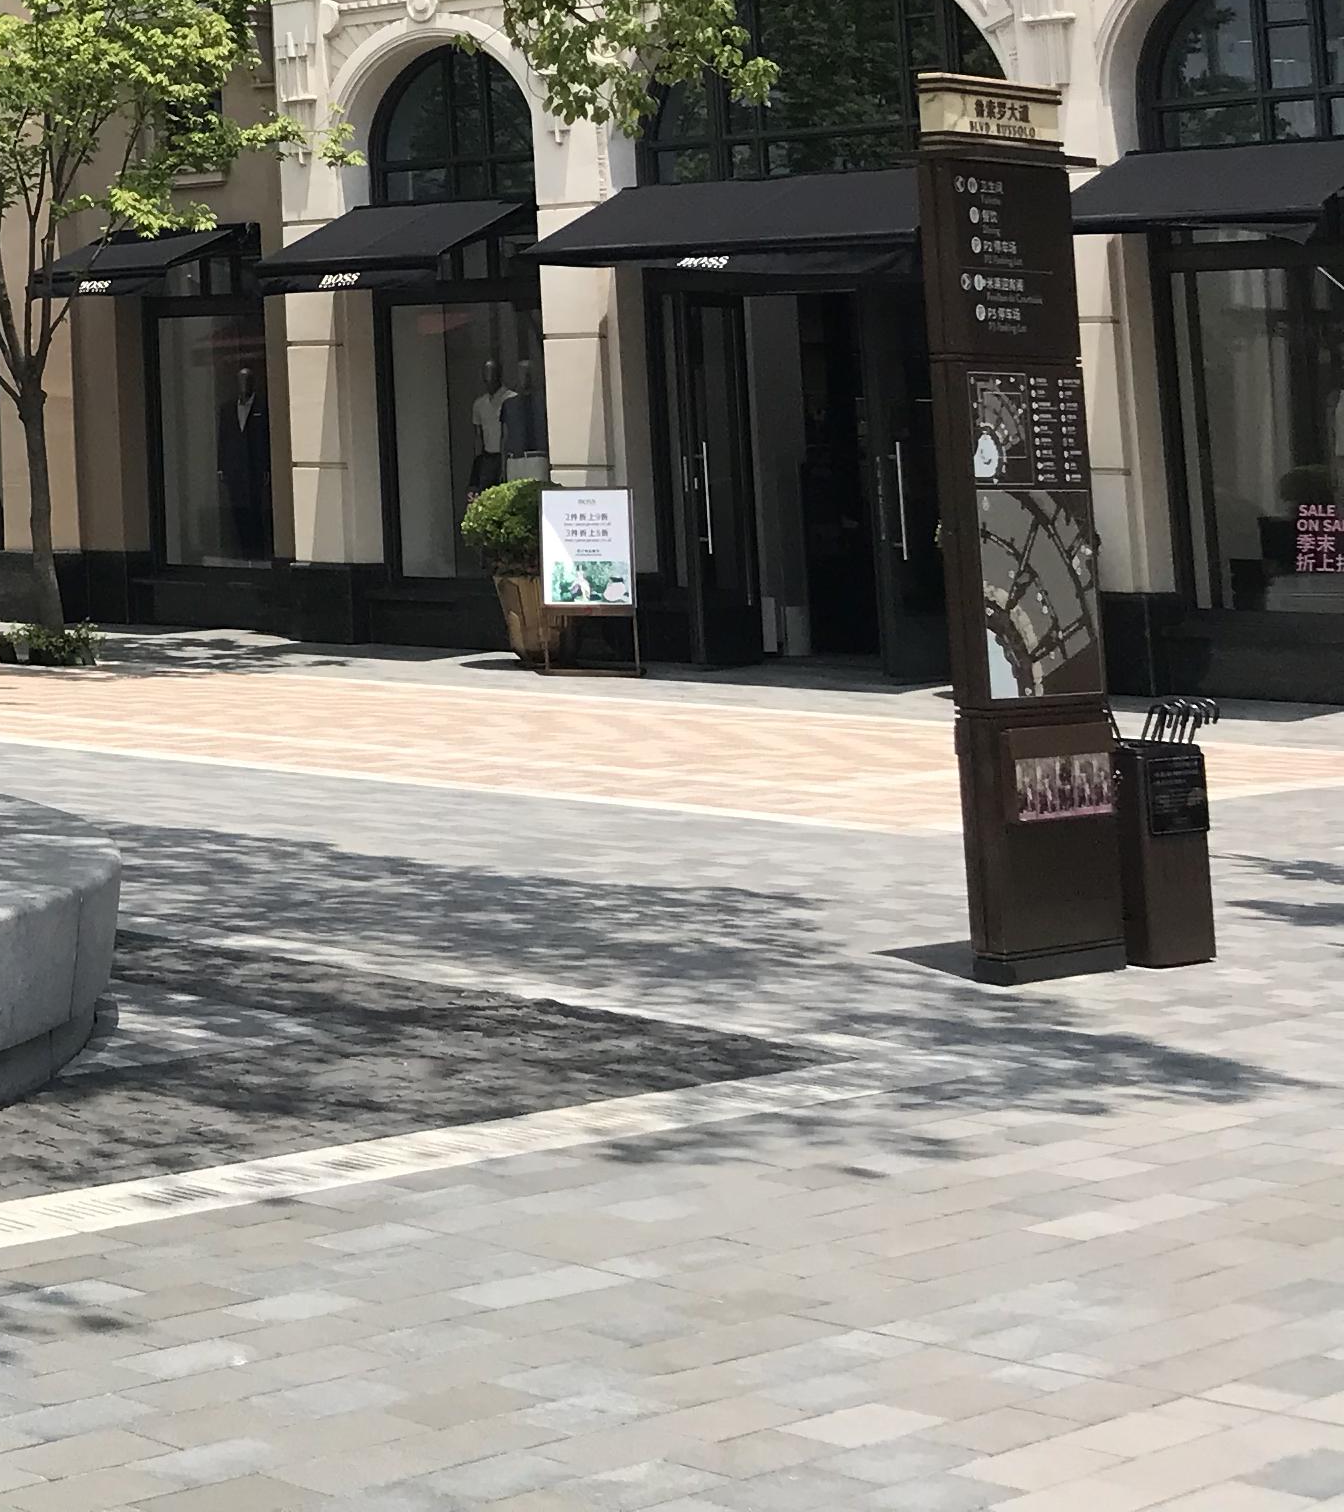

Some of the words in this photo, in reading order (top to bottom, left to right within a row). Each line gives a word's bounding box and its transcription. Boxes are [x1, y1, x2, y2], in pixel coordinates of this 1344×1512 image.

[975, 99, 1030, 123] 鲁索罗大道
[996, 123, 1036, 138] RUSSOLO
[321, 272, 361, 284] BOSS
[79, 280, 111, 290] BOSS
[1299, 505, 1335, 516] SALE
[1297, 519, 1319, 531] ON
[1297, 534, 1335, 552] 季末
